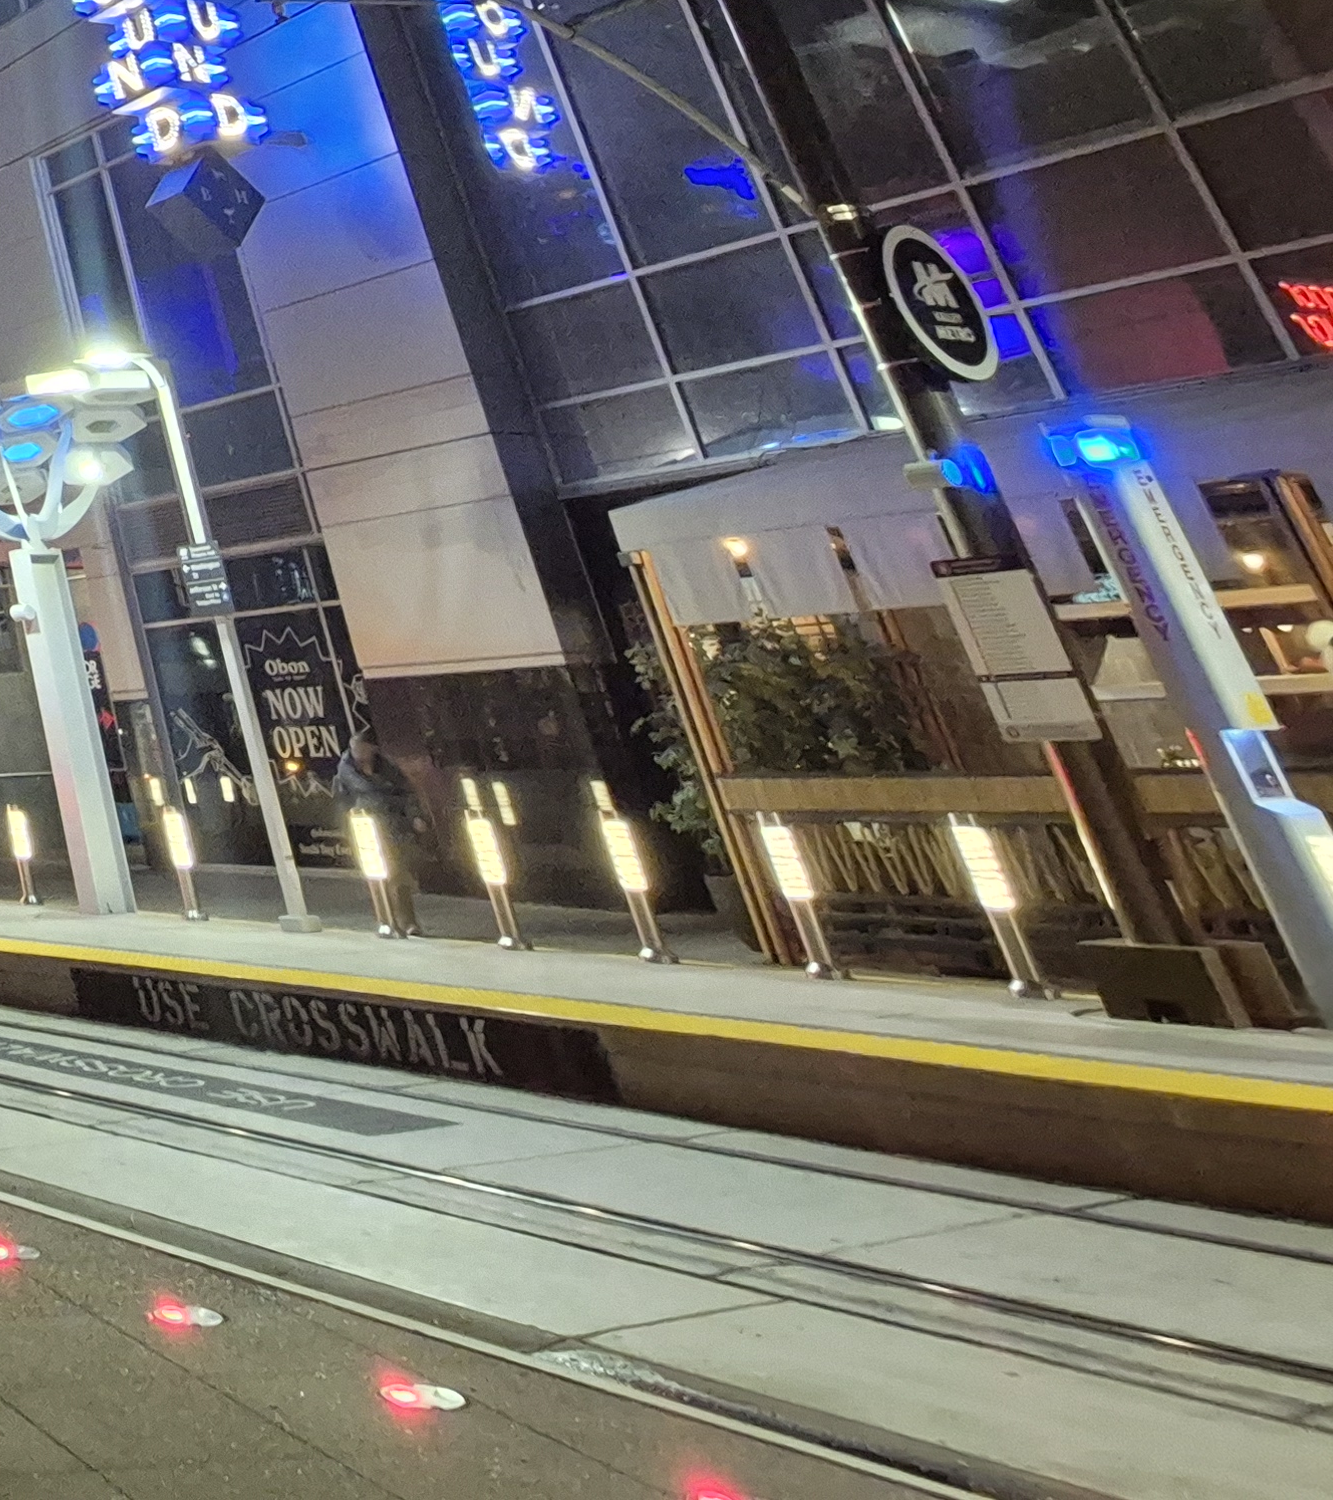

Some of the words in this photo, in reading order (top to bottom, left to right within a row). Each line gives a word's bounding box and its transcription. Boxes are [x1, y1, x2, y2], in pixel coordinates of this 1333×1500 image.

[264, 657, 311, 676] Obon
[262, 686, 324, 720] NOW
[272, 726, 341, 759] OPEN
[133, 977, 209, 1031] USE
[229, 990, 503, 1077] CROSSWALK
